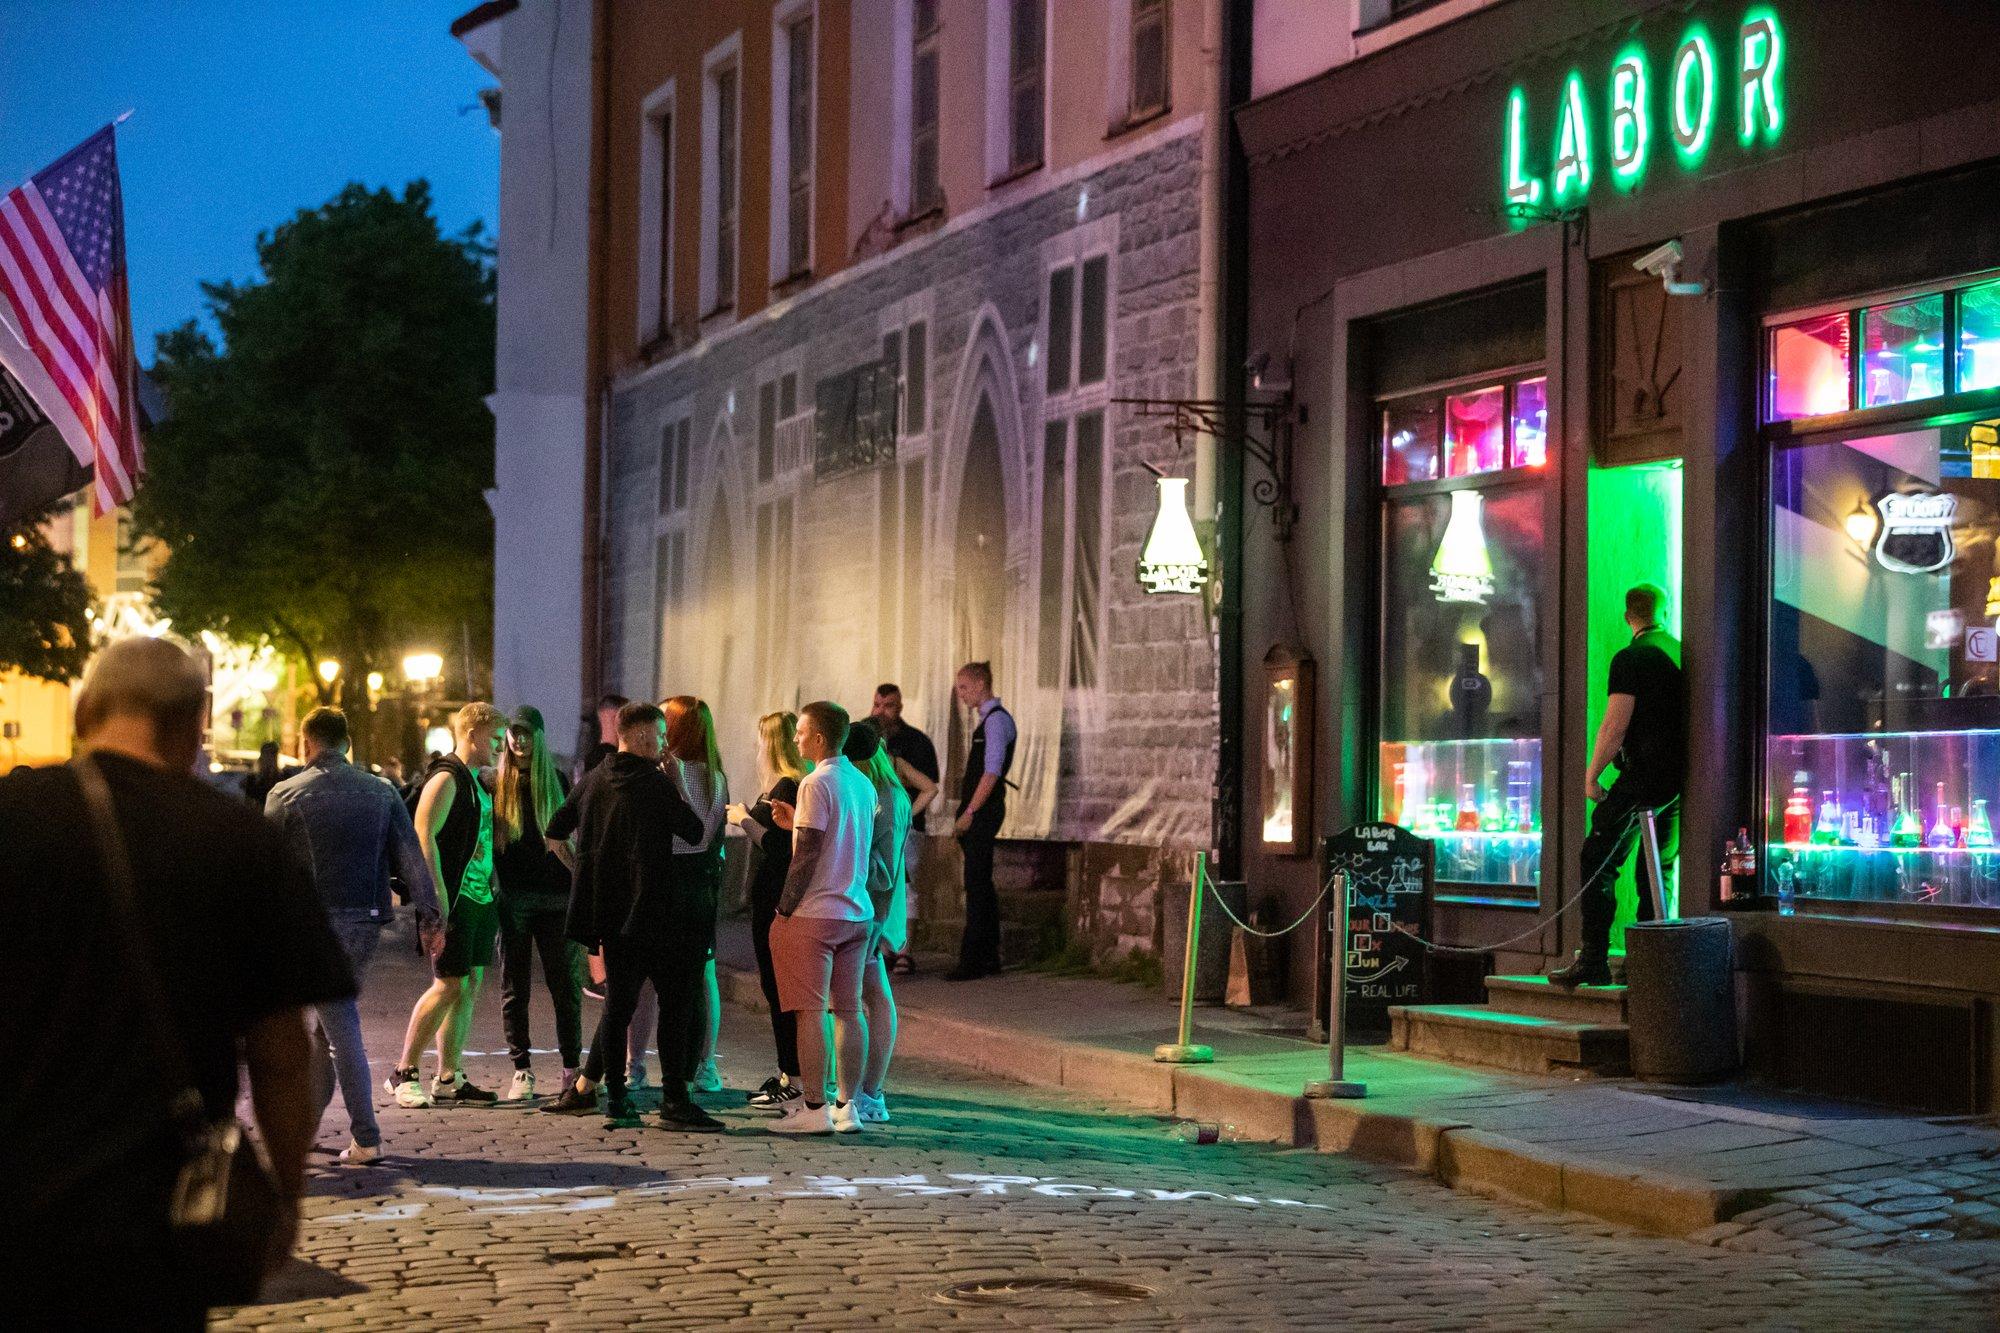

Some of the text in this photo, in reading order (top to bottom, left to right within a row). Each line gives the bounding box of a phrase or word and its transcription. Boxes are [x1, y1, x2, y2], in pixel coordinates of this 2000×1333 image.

[1506, 14, 1783, 204] LABOR
[1355, 826, 1395, 841] LABOR
[1367, 840, 1388, 852] BAR
[1361, 984, 1418, 998] REAL LIFE
